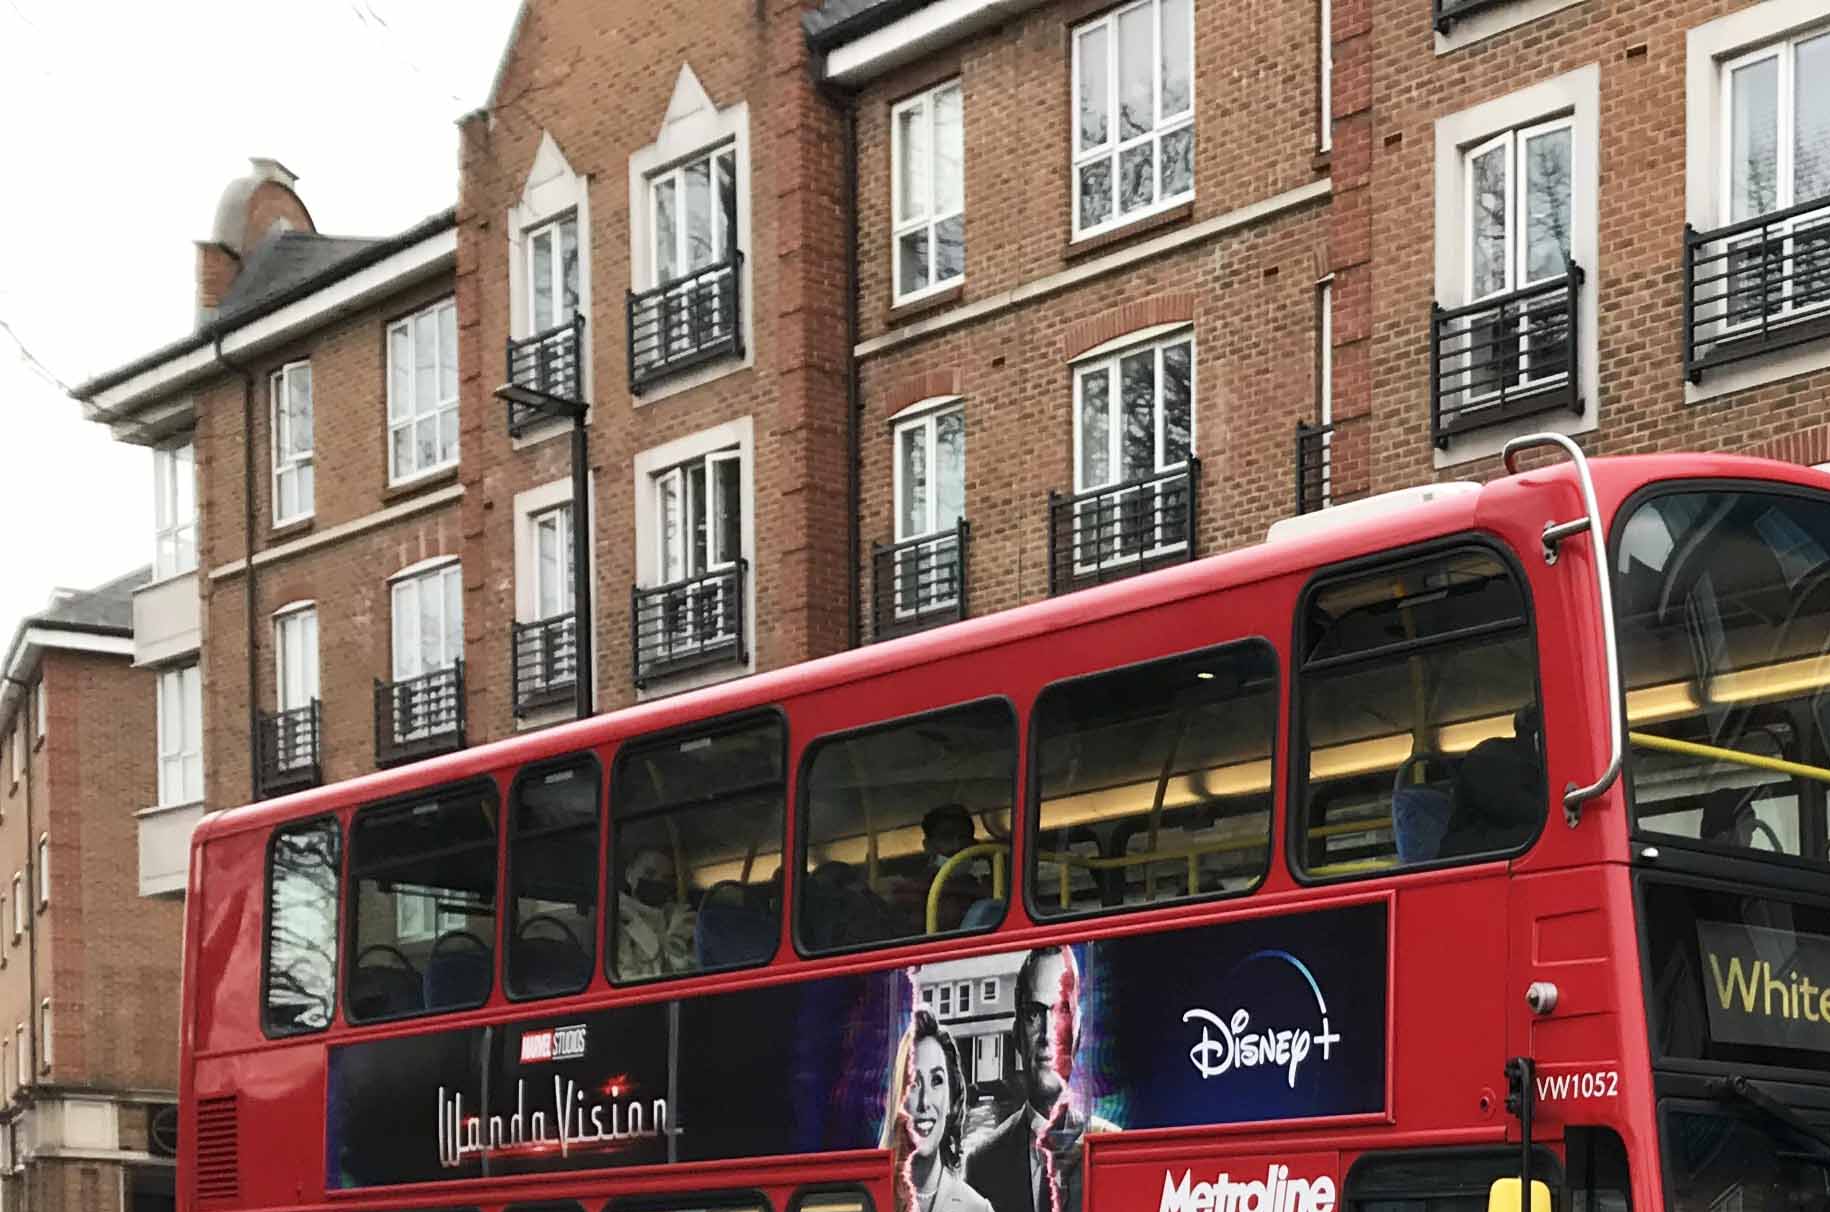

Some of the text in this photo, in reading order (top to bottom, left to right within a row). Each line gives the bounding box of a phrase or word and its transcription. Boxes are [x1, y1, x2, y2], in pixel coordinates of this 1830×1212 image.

[521, 1028, 587, 1061] MARVEL STUDIOS
[1536, 1071, 1619, 1102] VW1052
